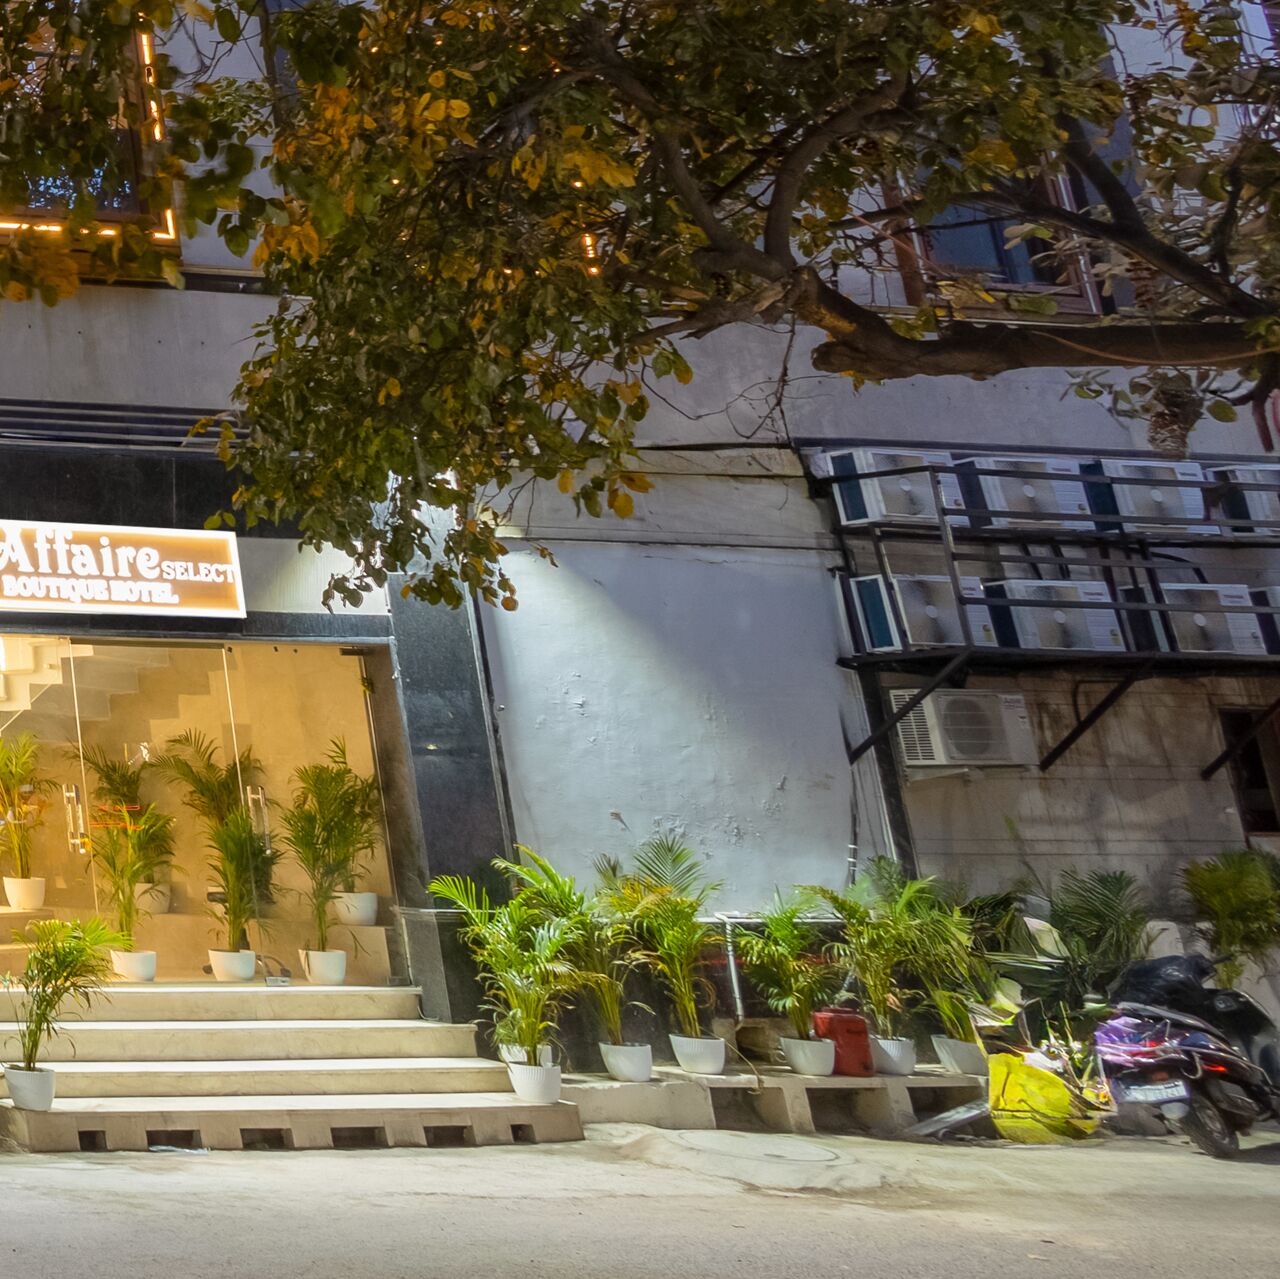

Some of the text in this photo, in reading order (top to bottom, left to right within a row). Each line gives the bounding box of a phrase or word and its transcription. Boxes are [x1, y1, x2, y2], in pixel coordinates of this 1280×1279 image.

[161, 560, 236, 584] SELECT
[2, 575, 180, 604] BOUTIQUE HOTEL
